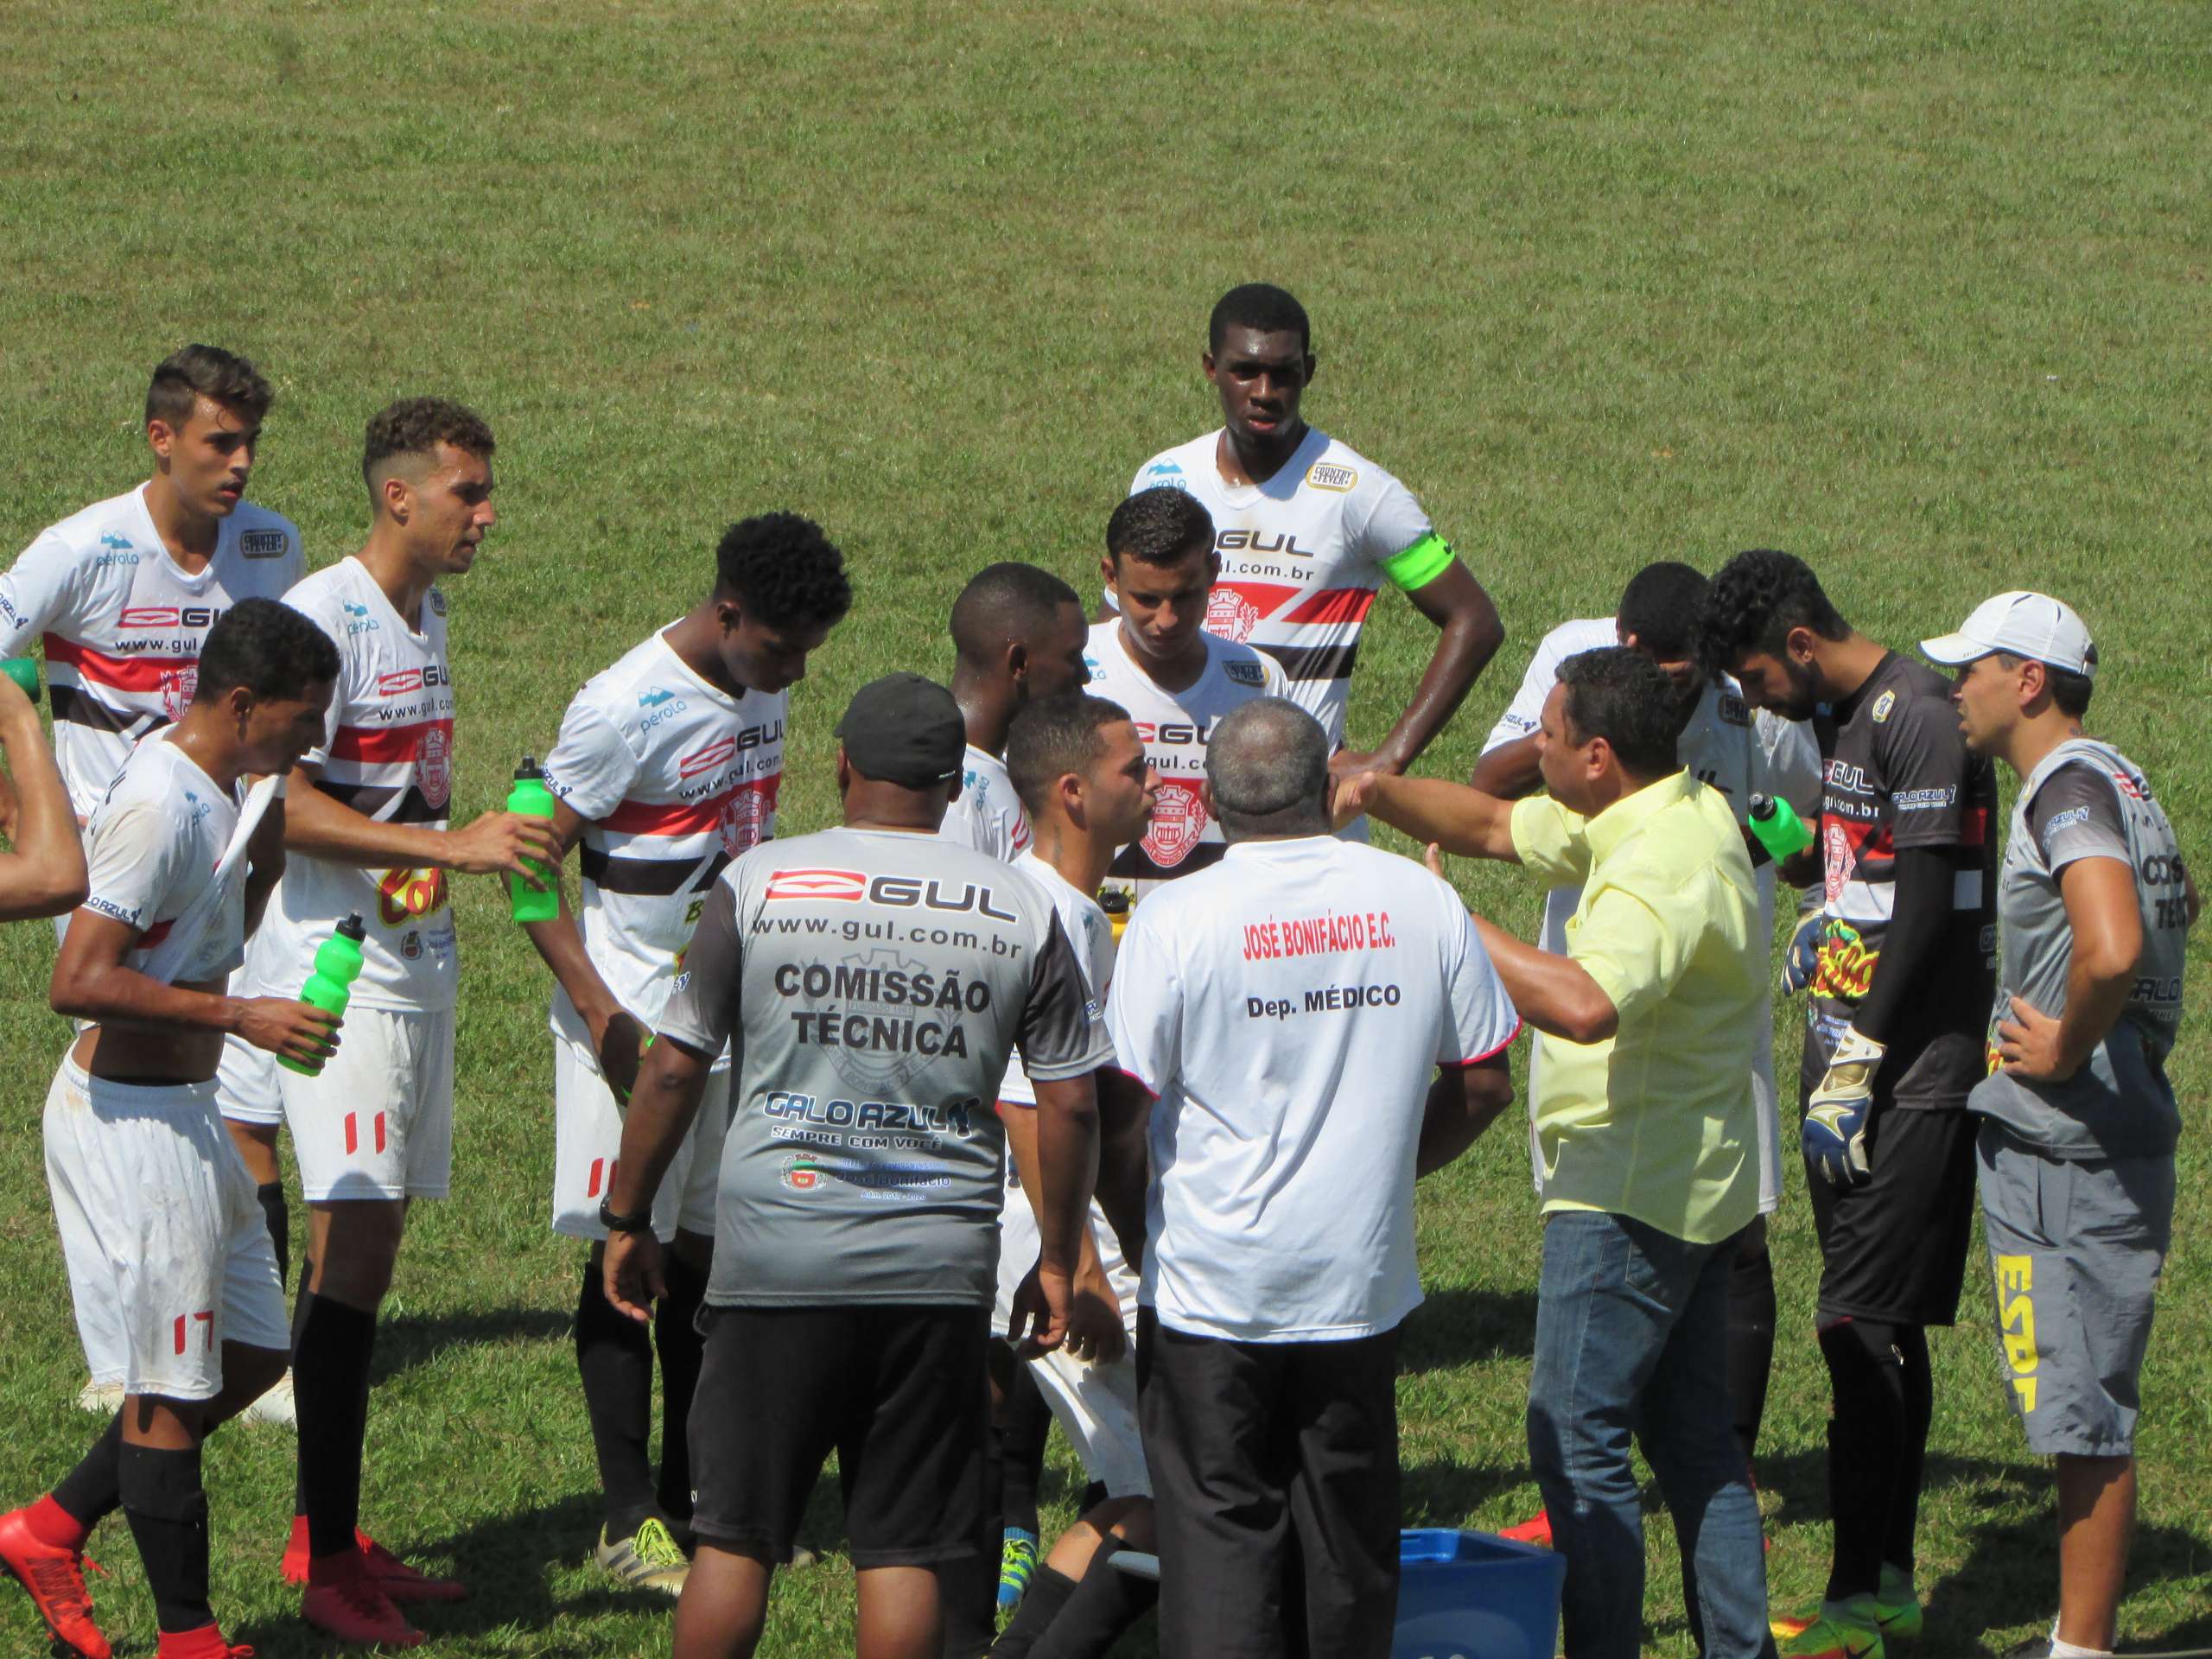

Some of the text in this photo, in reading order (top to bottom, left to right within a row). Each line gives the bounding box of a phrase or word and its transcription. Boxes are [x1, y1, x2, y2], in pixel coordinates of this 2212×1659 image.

[1314, 467, 1353, 478] COUNTRY
[1318, 473, 1344, 485] FEVER
[97, 551, 139, 569] pérola
[1216, 530, 1314, 558] GUL
[115, 637, 203, 652] www.gul.
[423, 665, 450, 688] GU
[639, 698, 688, 735] pérola
[1159, 723, 1210, 746] GU
[868, 874, 1018, 924] GUL
[753, 917, 1022, 959] www.gul.com.br
[1243, 908, 1396, 961] JOSÉ BONIFÁCIO E.C.
[774, 963, 991, 1014] COMISSÃO
[1247, 983, 1402, 1020] Dep. MÉDICO
[791, 1004, 969, 1059] TÉCNICA
[345, 1111, 385, 1155] 11
[771, 1125, 944, 1151] SEMPRE COM VOCÊ
[174, 1310, 215, 1356] 17
